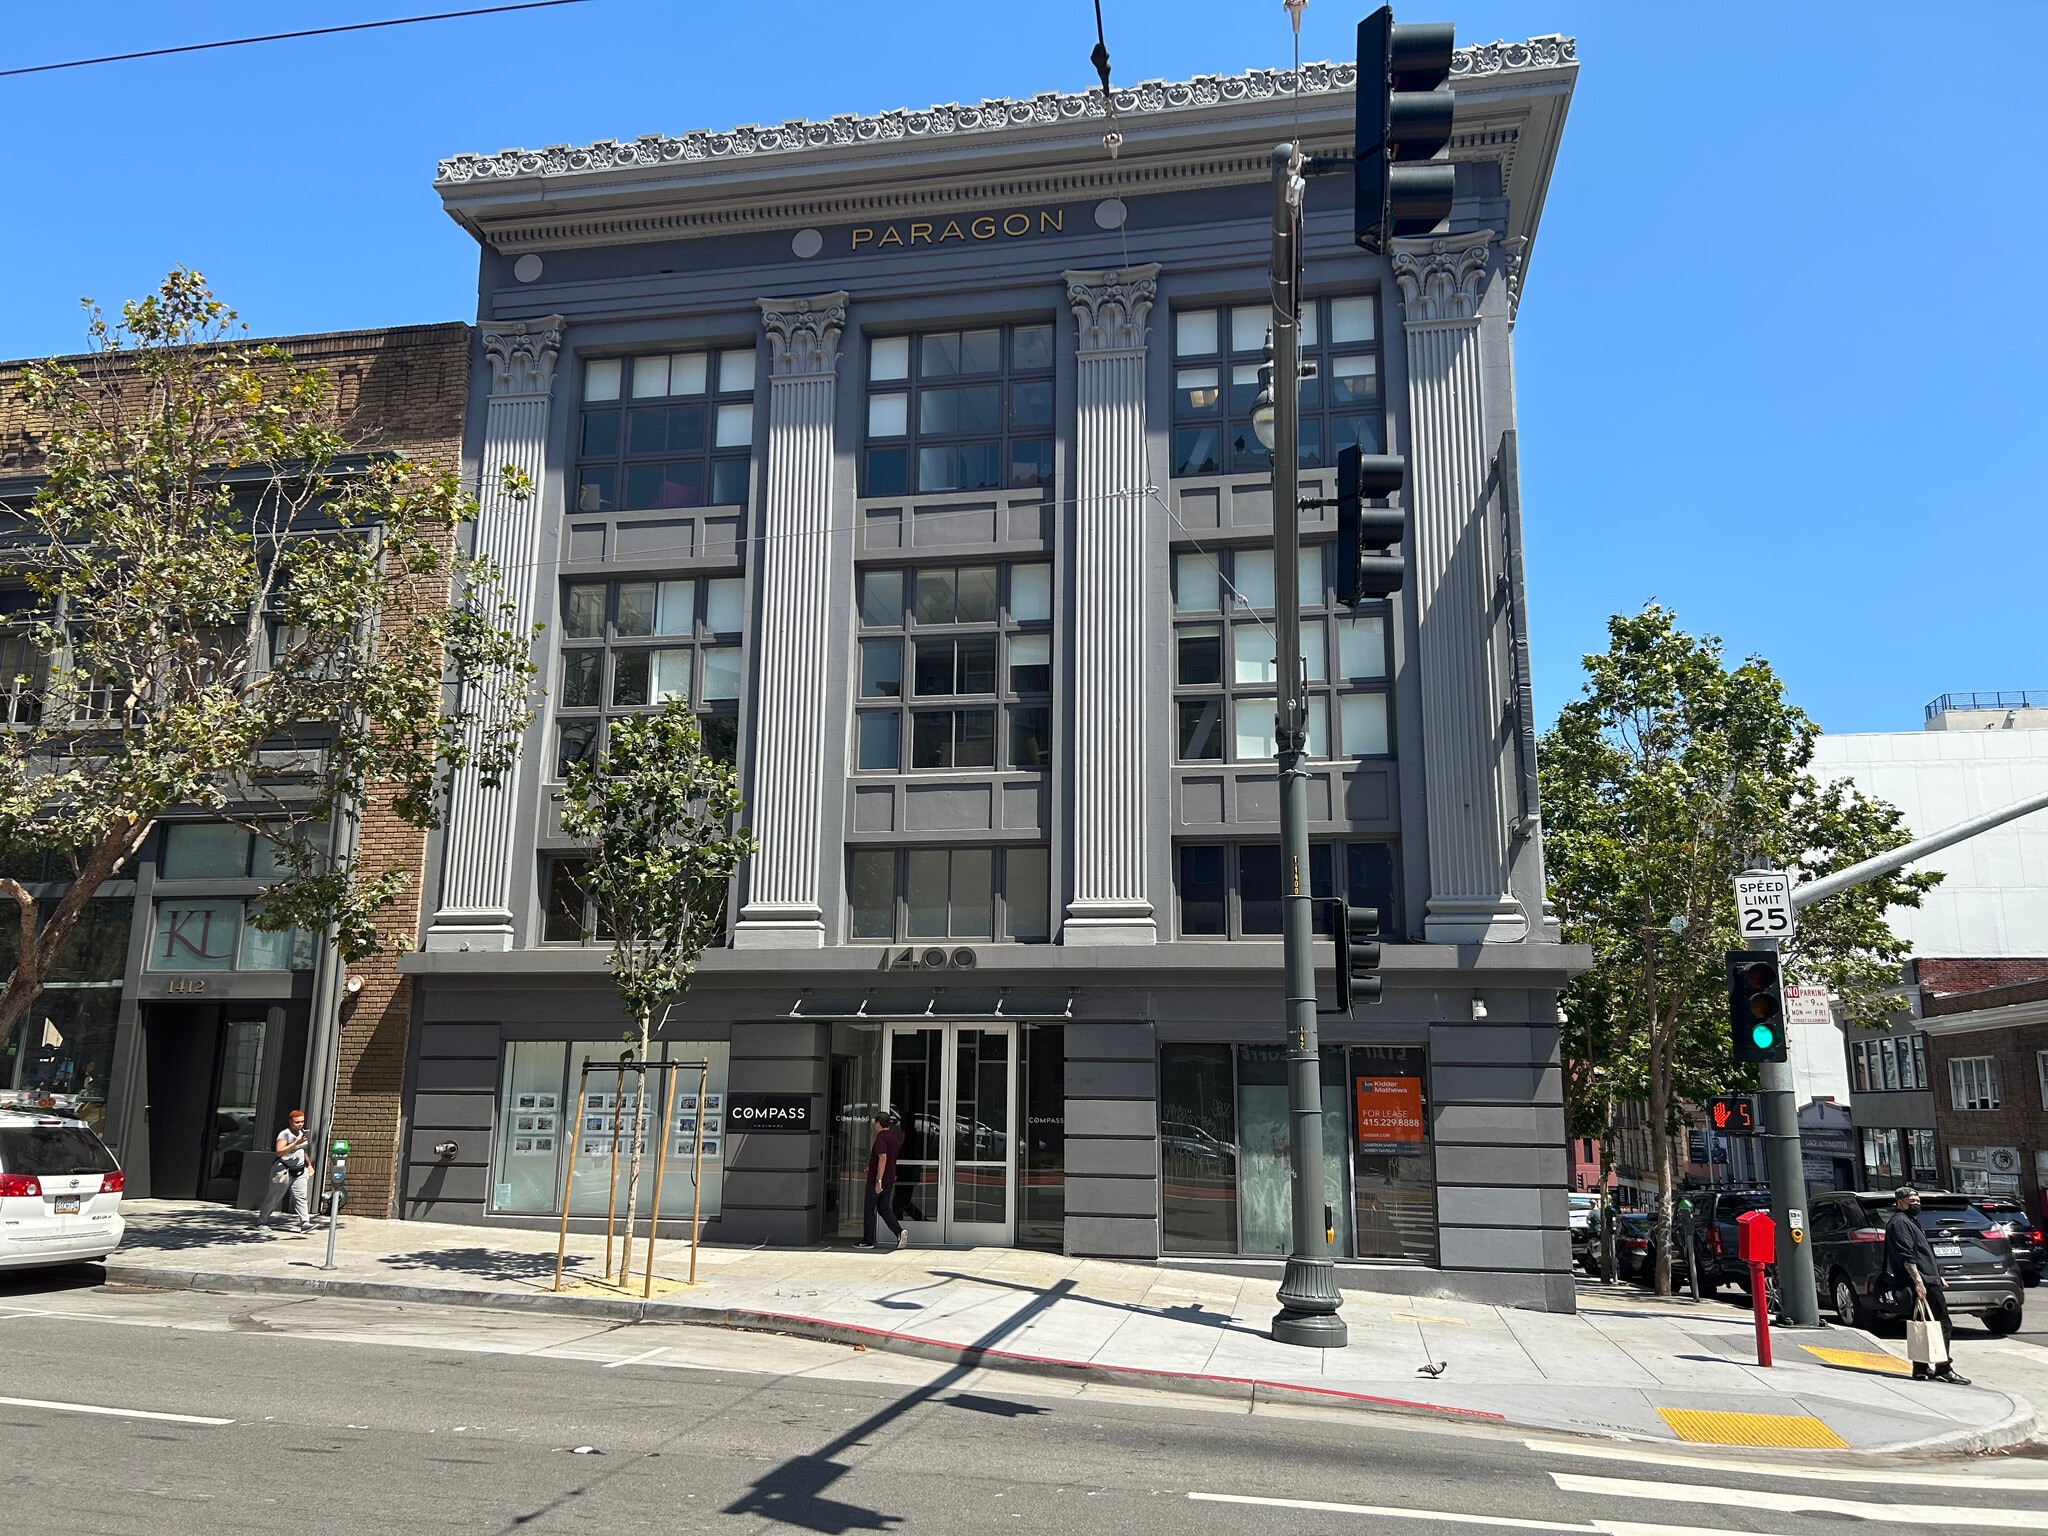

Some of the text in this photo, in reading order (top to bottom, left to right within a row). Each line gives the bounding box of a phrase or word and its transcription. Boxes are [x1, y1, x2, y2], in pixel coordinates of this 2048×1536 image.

[851, 209, 1064, 250] PARAGON
[1739, 882, 1784, 893] SPEED
[1745, 894, 1781, 905] LIMIT
[1743, 908, 1788, 931] 25
[160, 909, 232, 960] KL
[878, 946, 977, 972] 1400
[167, 980, 206, 994] 1412
[1787, 987, 1826, 997] NO PARKING
[732, 1106, 806, 1119] COMPASS
[1362, 1110, 1408, 1118] FOR LEASE
[1739, 1103, 1751, 1126] 5
[1028, 1116, 1064, 1124] COMPASS
[1362, 1118, 1420, 1127] 415.229.8888
